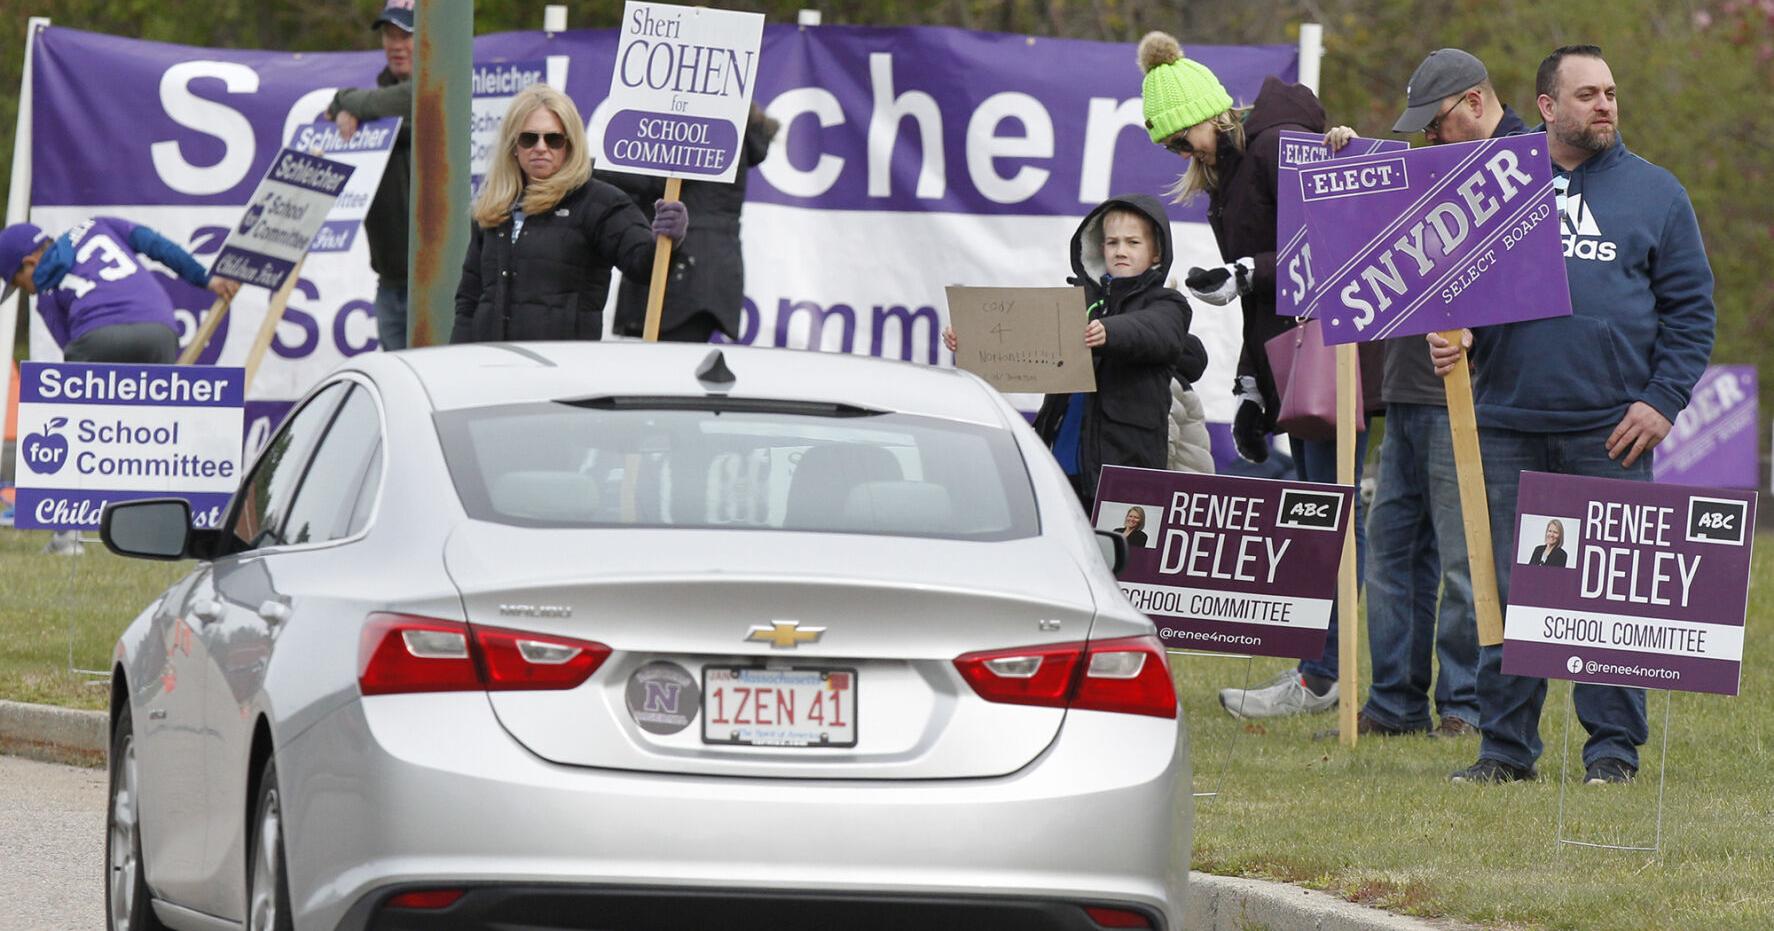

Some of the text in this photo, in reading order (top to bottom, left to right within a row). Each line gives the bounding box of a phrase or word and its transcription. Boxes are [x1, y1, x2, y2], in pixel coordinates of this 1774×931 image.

[630, 7, 681, 39] Sheri
[620, 40, 754, 99] COHEN
[671, 95, 688, 112] for
[637, 118, 711, 144] SCHOOL
[613, 139, 726, 169] COMMITTEE
[1286, 143, 1327, 164] ELECT
[275, 154, 346, 191] Schleicher
[1313, 165, 1392, 194] ELECT
[1341, 149, 1533, 332] SNYDER
[1441, 203, 1550, 304] SELECT BOARD
[59, 234, 138, 299] 13
[38, 368, 228, 402] Schleicher
[77, 419, 179, 445] School
[30, 442, 64, 463] for
[76, 452, 234, 478] Committee
[35, 498, 102, 526] Child
[1168, 491, 1265, 532] RENEE
[1290, 502, 1330, 518] ABC
[1585, 500, 1674, 547] RENEE
[1698, 511, 1735, 530] ABC
[1159, 529, 1292, 584] DELEY
[1580, 544, 1701, 608] DELEY
[1190, 595, 1293, 623] COMMITTEE
[1160, 627, 1262, 646] @renee4norton
[1543, 615, 1707, 653] SCHOOL COMMITTEE
[1586, 660, 1680, 680] @renee4norton
[643, 681, 680, 714] N
[712, 687, 847, 727] 1ZEN 41
